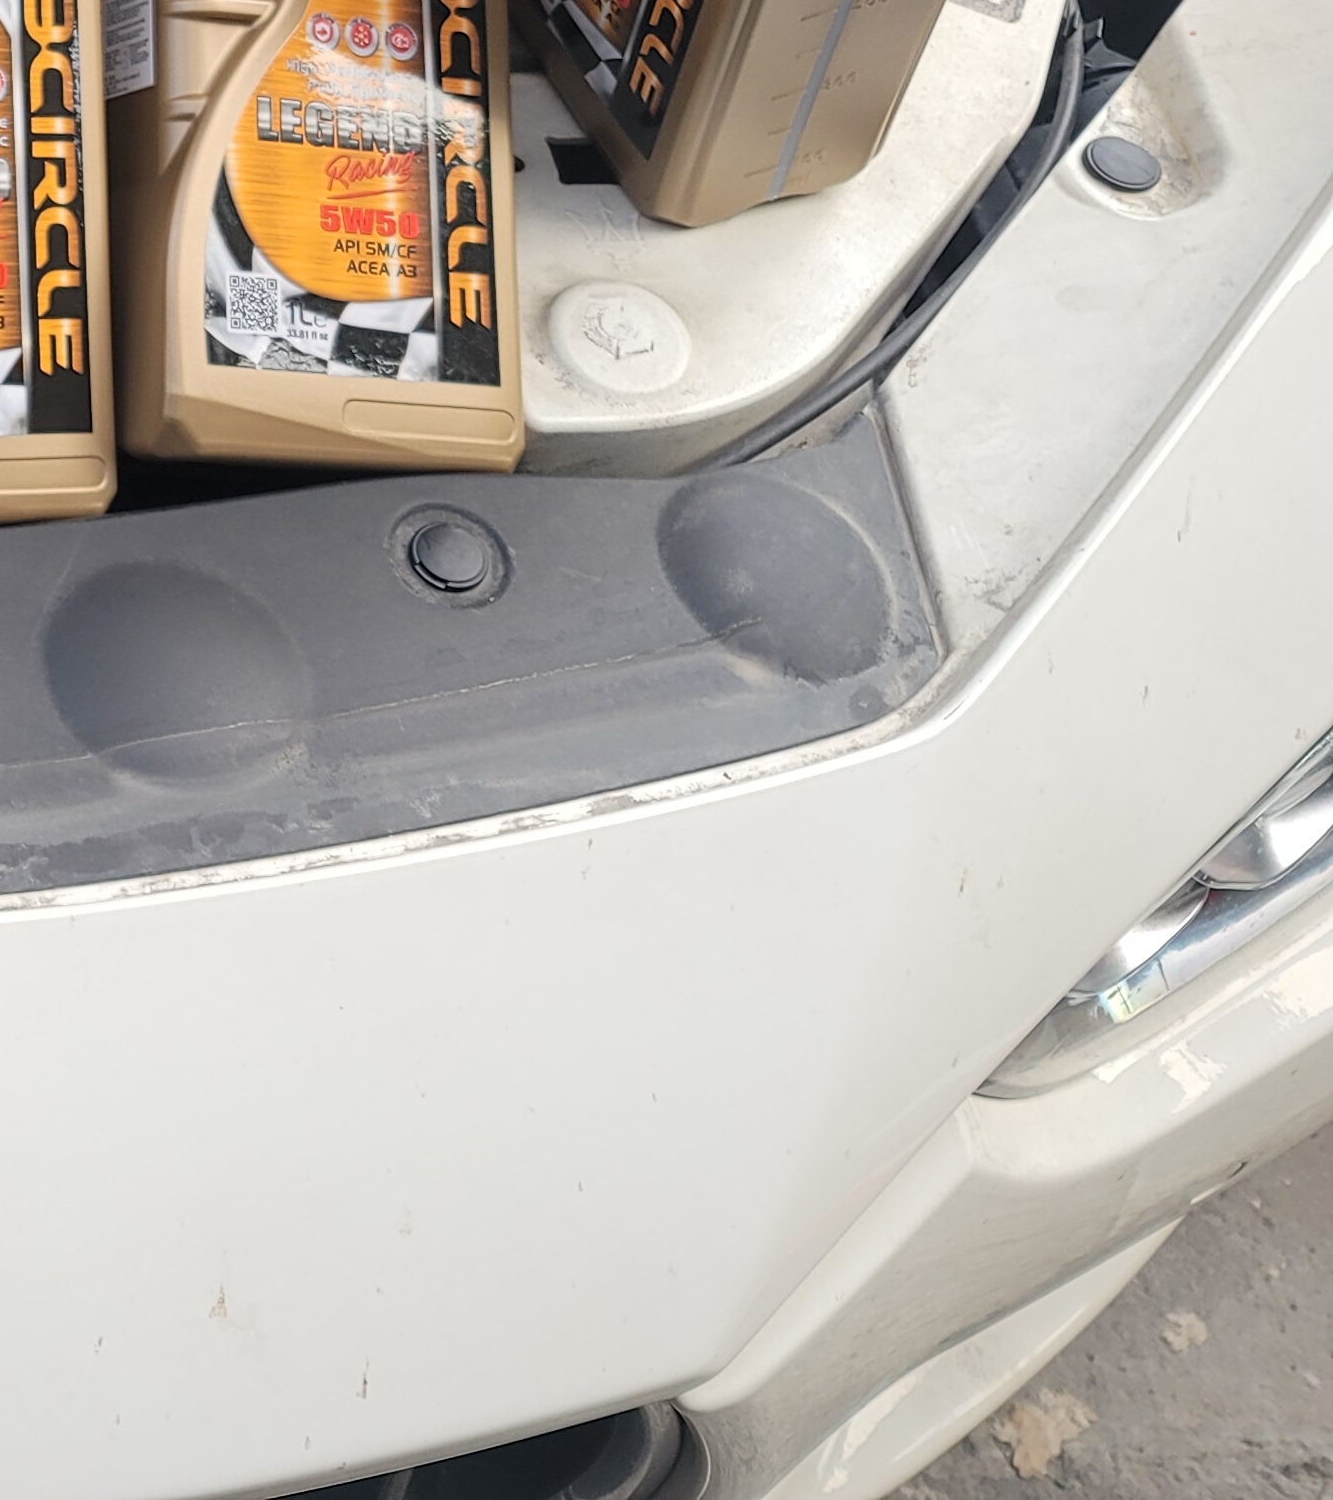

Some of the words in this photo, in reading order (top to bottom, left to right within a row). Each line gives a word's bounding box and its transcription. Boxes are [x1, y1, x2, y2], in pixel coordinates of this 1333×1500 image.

[256, 96, 424, 154] LEGEND
[325, 151, 416, 191] Racing
[319, 204, 420, 239] 5W50
[333, 239, 360, 254] API
[365, 241, 418, 259] SM/CF
[347, 259, 390, 277] ACEA
[396, 264, 418, 278] A3
